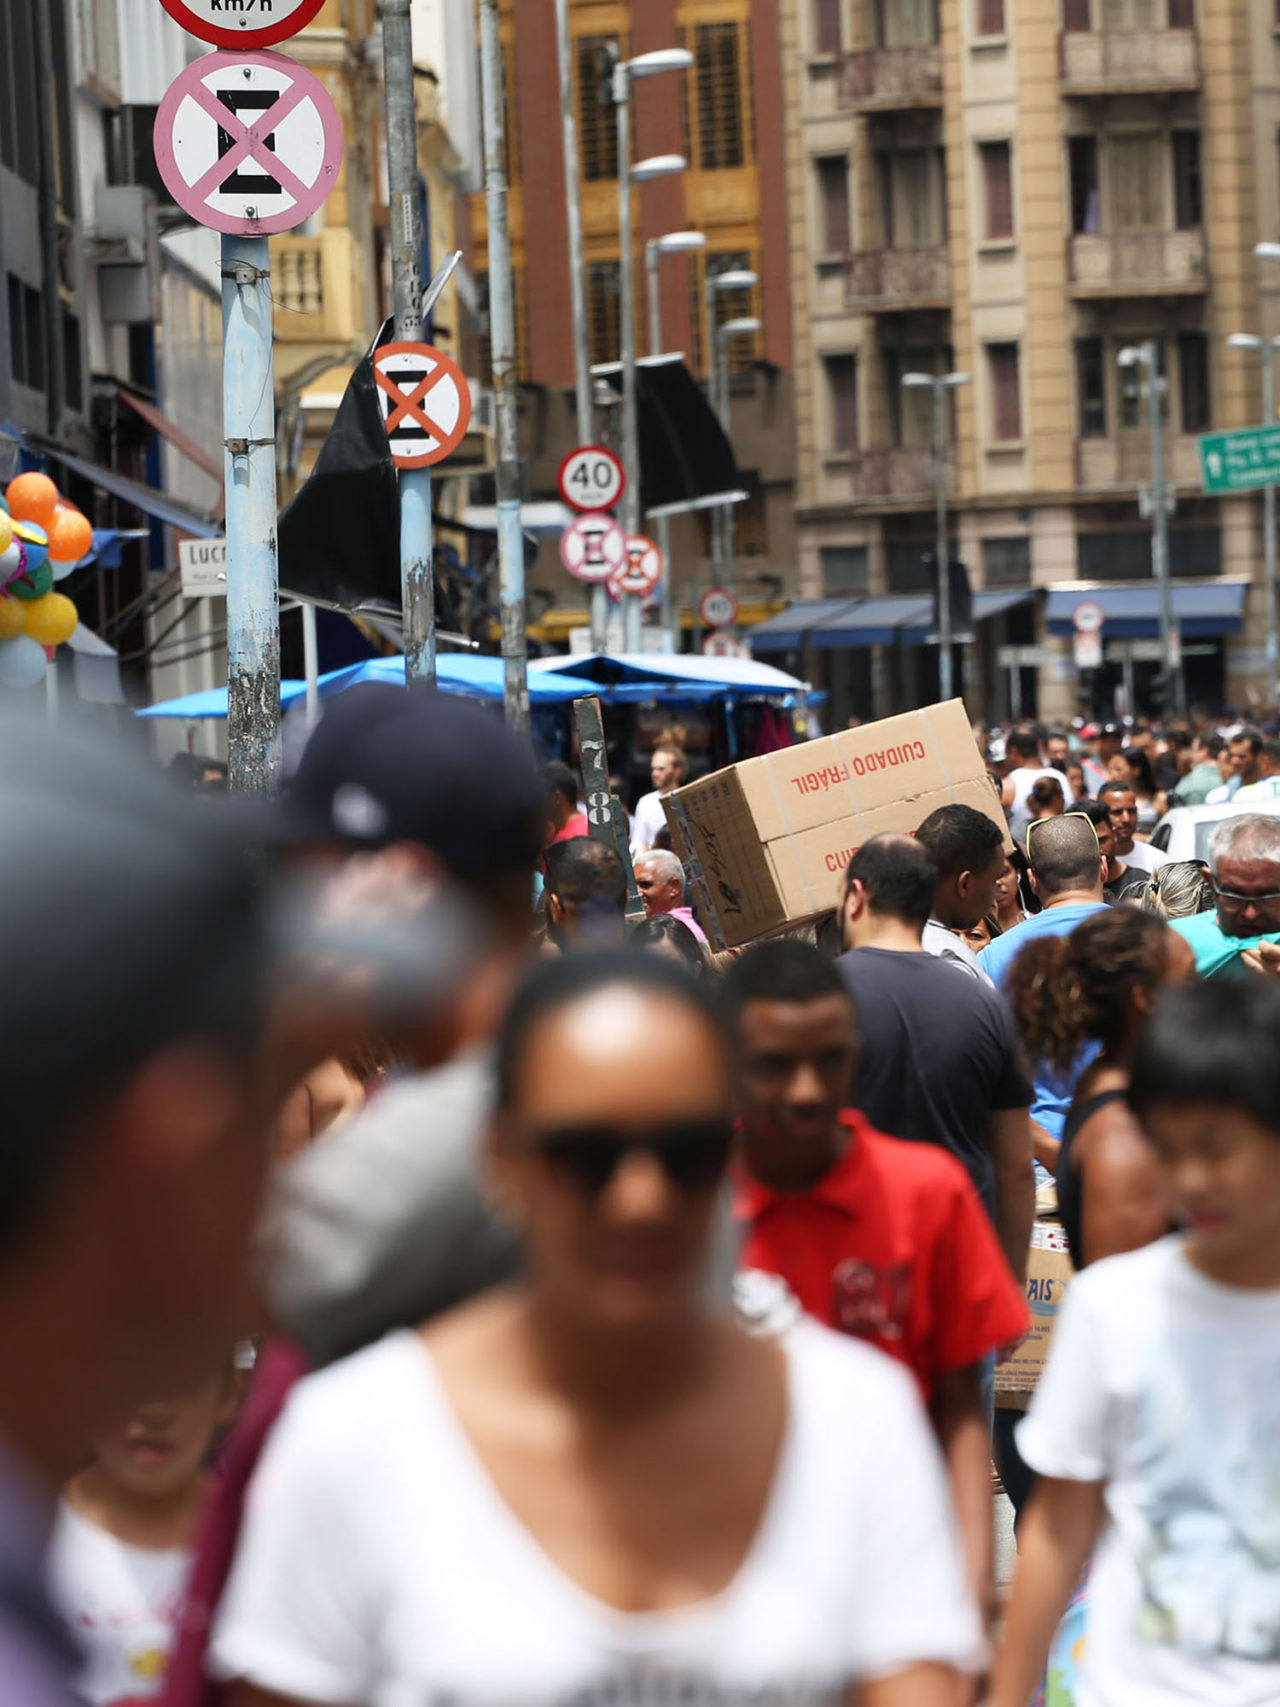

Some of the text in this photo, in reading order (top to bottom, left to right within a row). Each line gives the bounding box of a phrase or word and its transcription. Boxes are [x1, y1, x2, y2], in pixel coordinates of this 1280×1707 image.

[571, 461, 612, 489] 40
[581, 740, 605, 770] 7
[791, 741, 926, 795] CUIDADO FRÁGIL
[588, 791, 612, 825] 8
